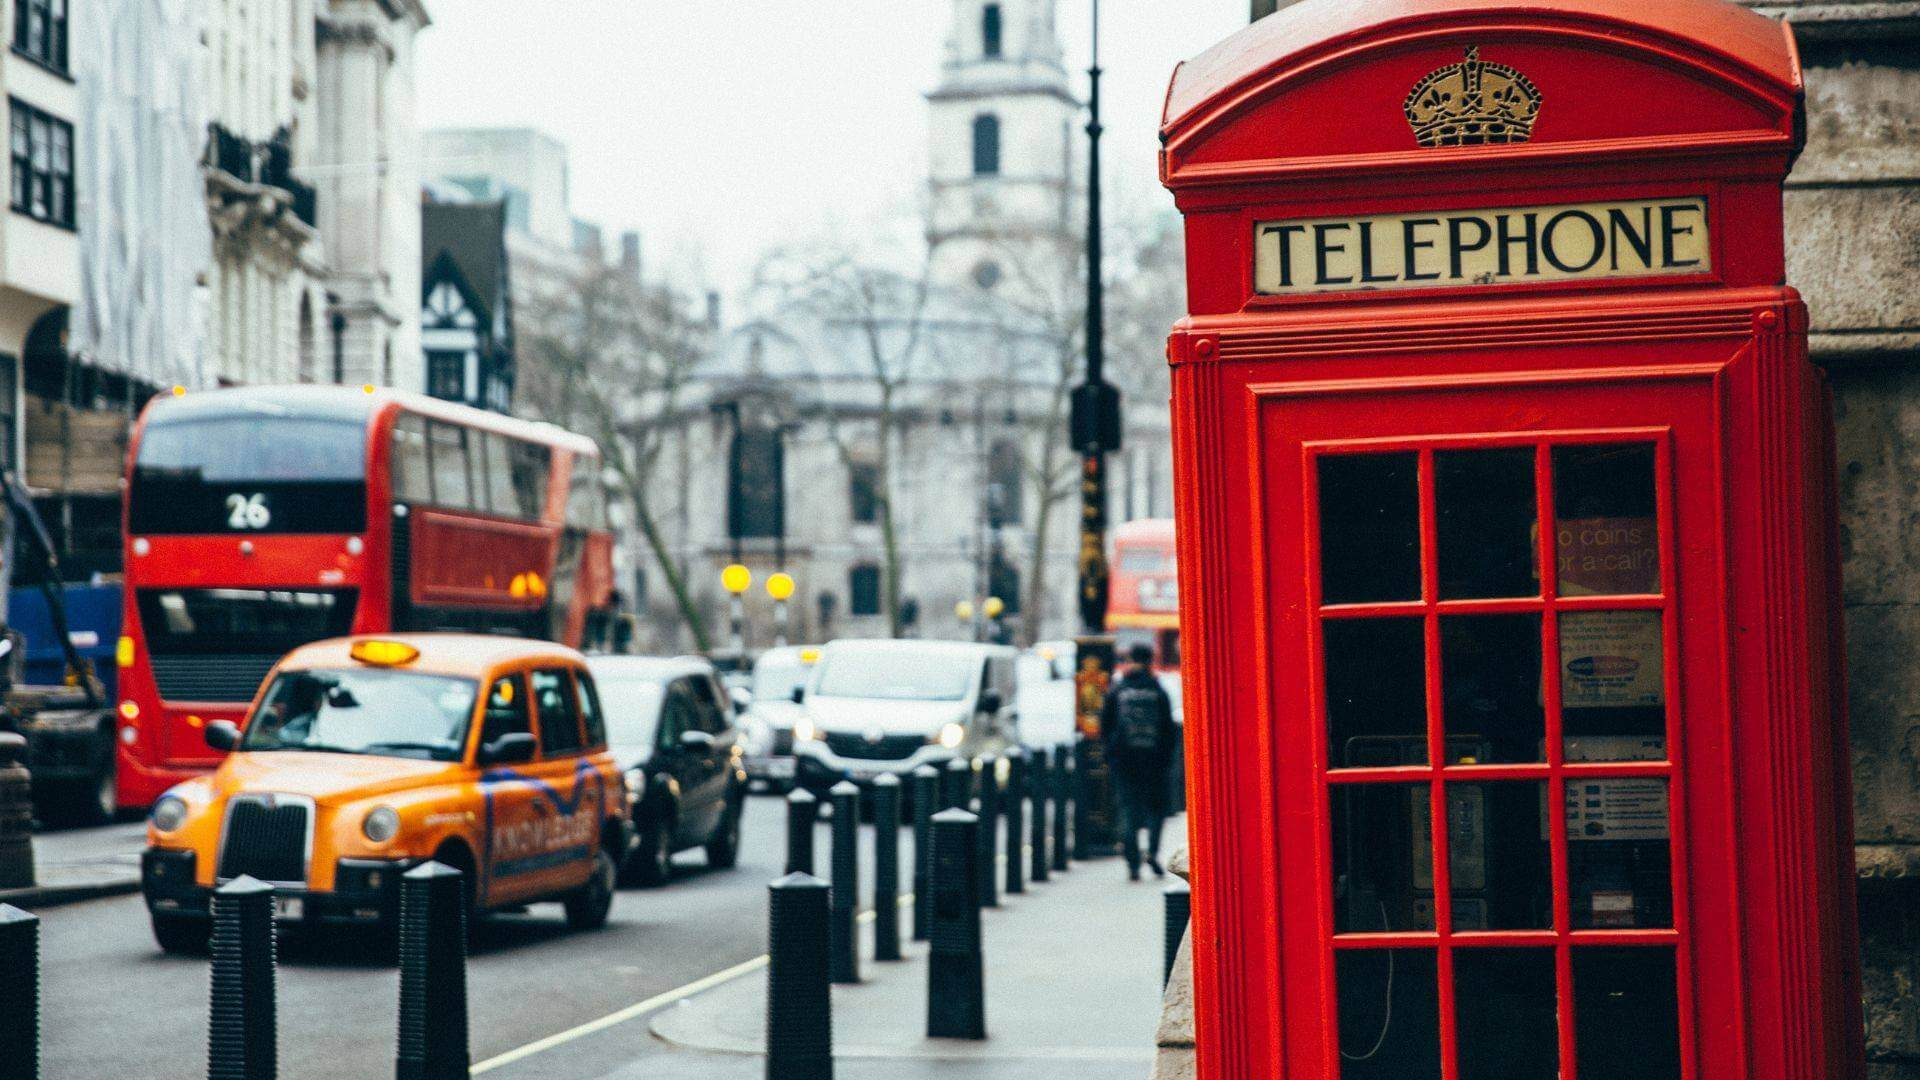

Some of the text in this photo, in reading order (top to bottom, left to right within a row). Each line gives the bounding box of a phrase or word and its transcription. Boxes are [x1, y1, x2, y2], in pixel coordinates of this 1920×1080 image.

[1262, 204, 1700, 287] TELEPHONE
[226, 493, 270, 529] 26
[1558, 527, 1641, 547] o coins
[1557, 547, 1655, 573] or a call?
